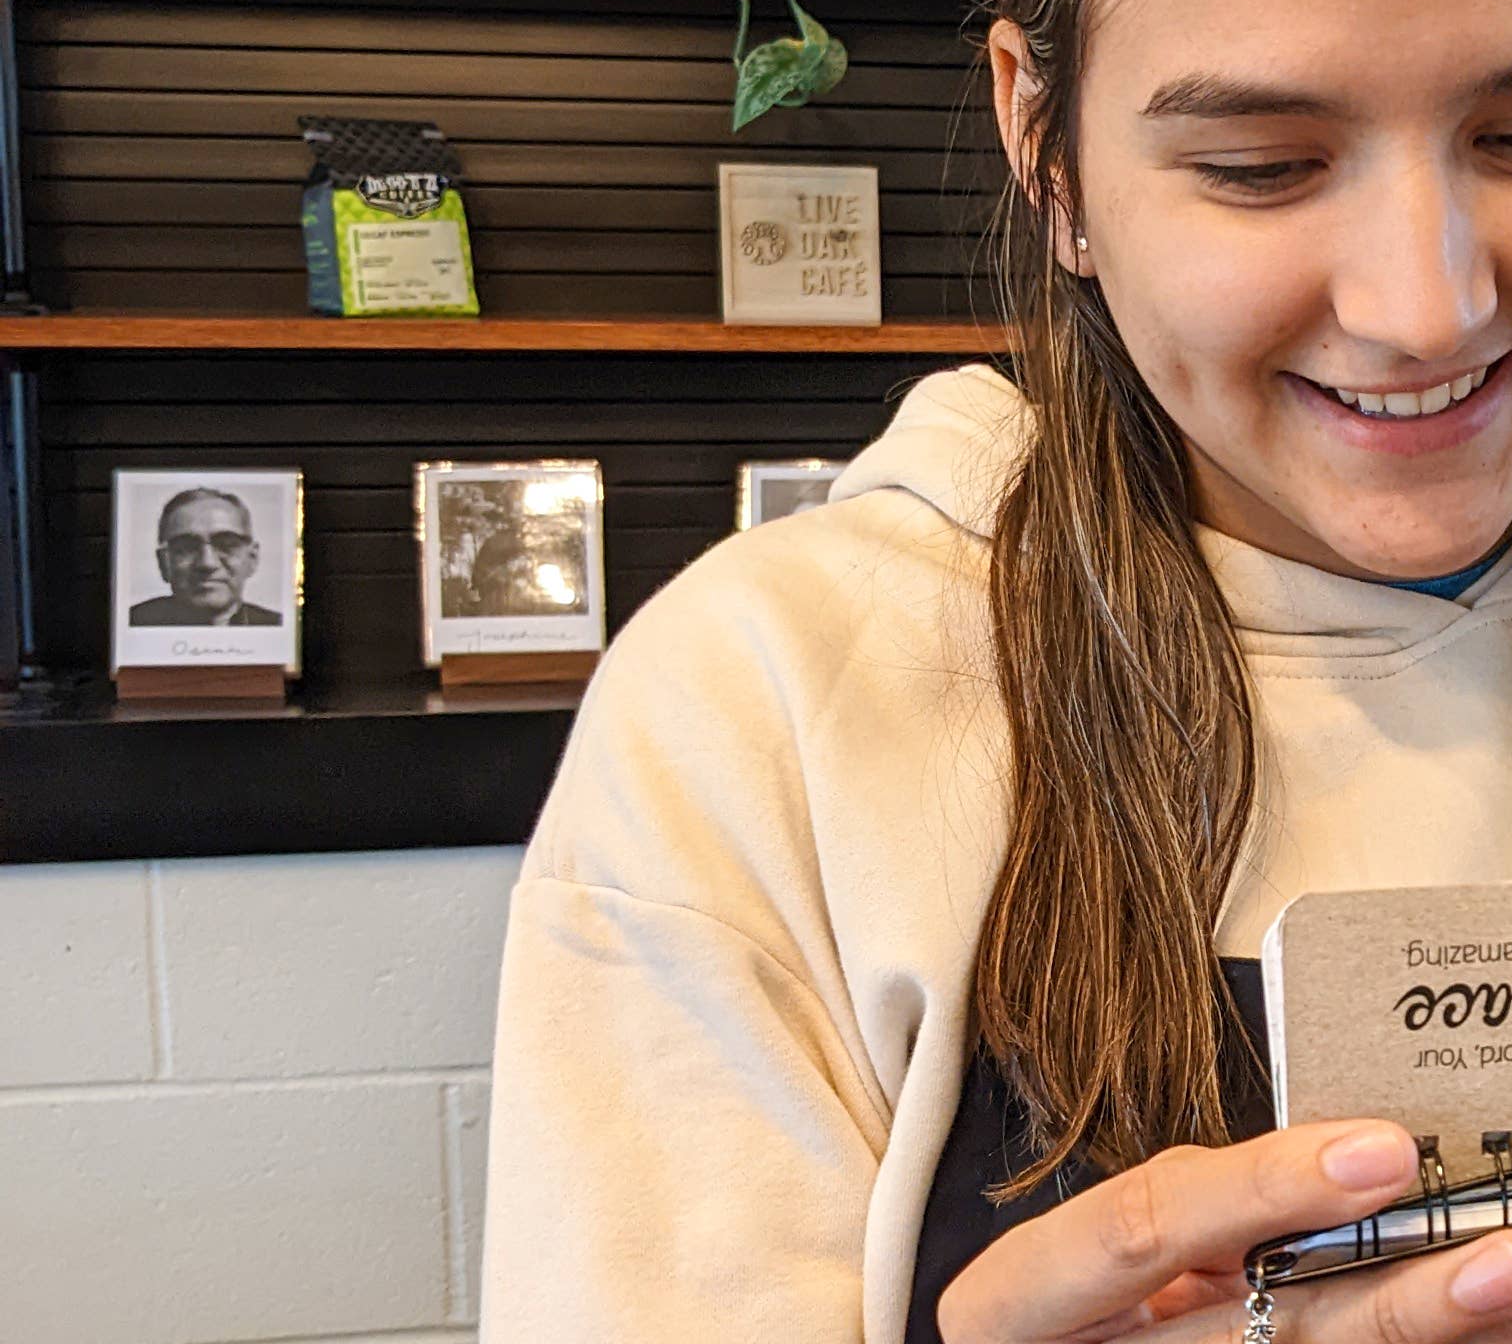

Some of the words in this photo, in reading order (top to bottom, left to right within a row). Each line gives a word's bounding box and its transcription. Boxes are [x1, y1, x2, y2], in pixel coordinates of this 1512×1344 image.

[797, 193, 860, 224] LIVE
[801, 231, 860, 261] OAK
[1412, 1046, 1469, 1071] Your
